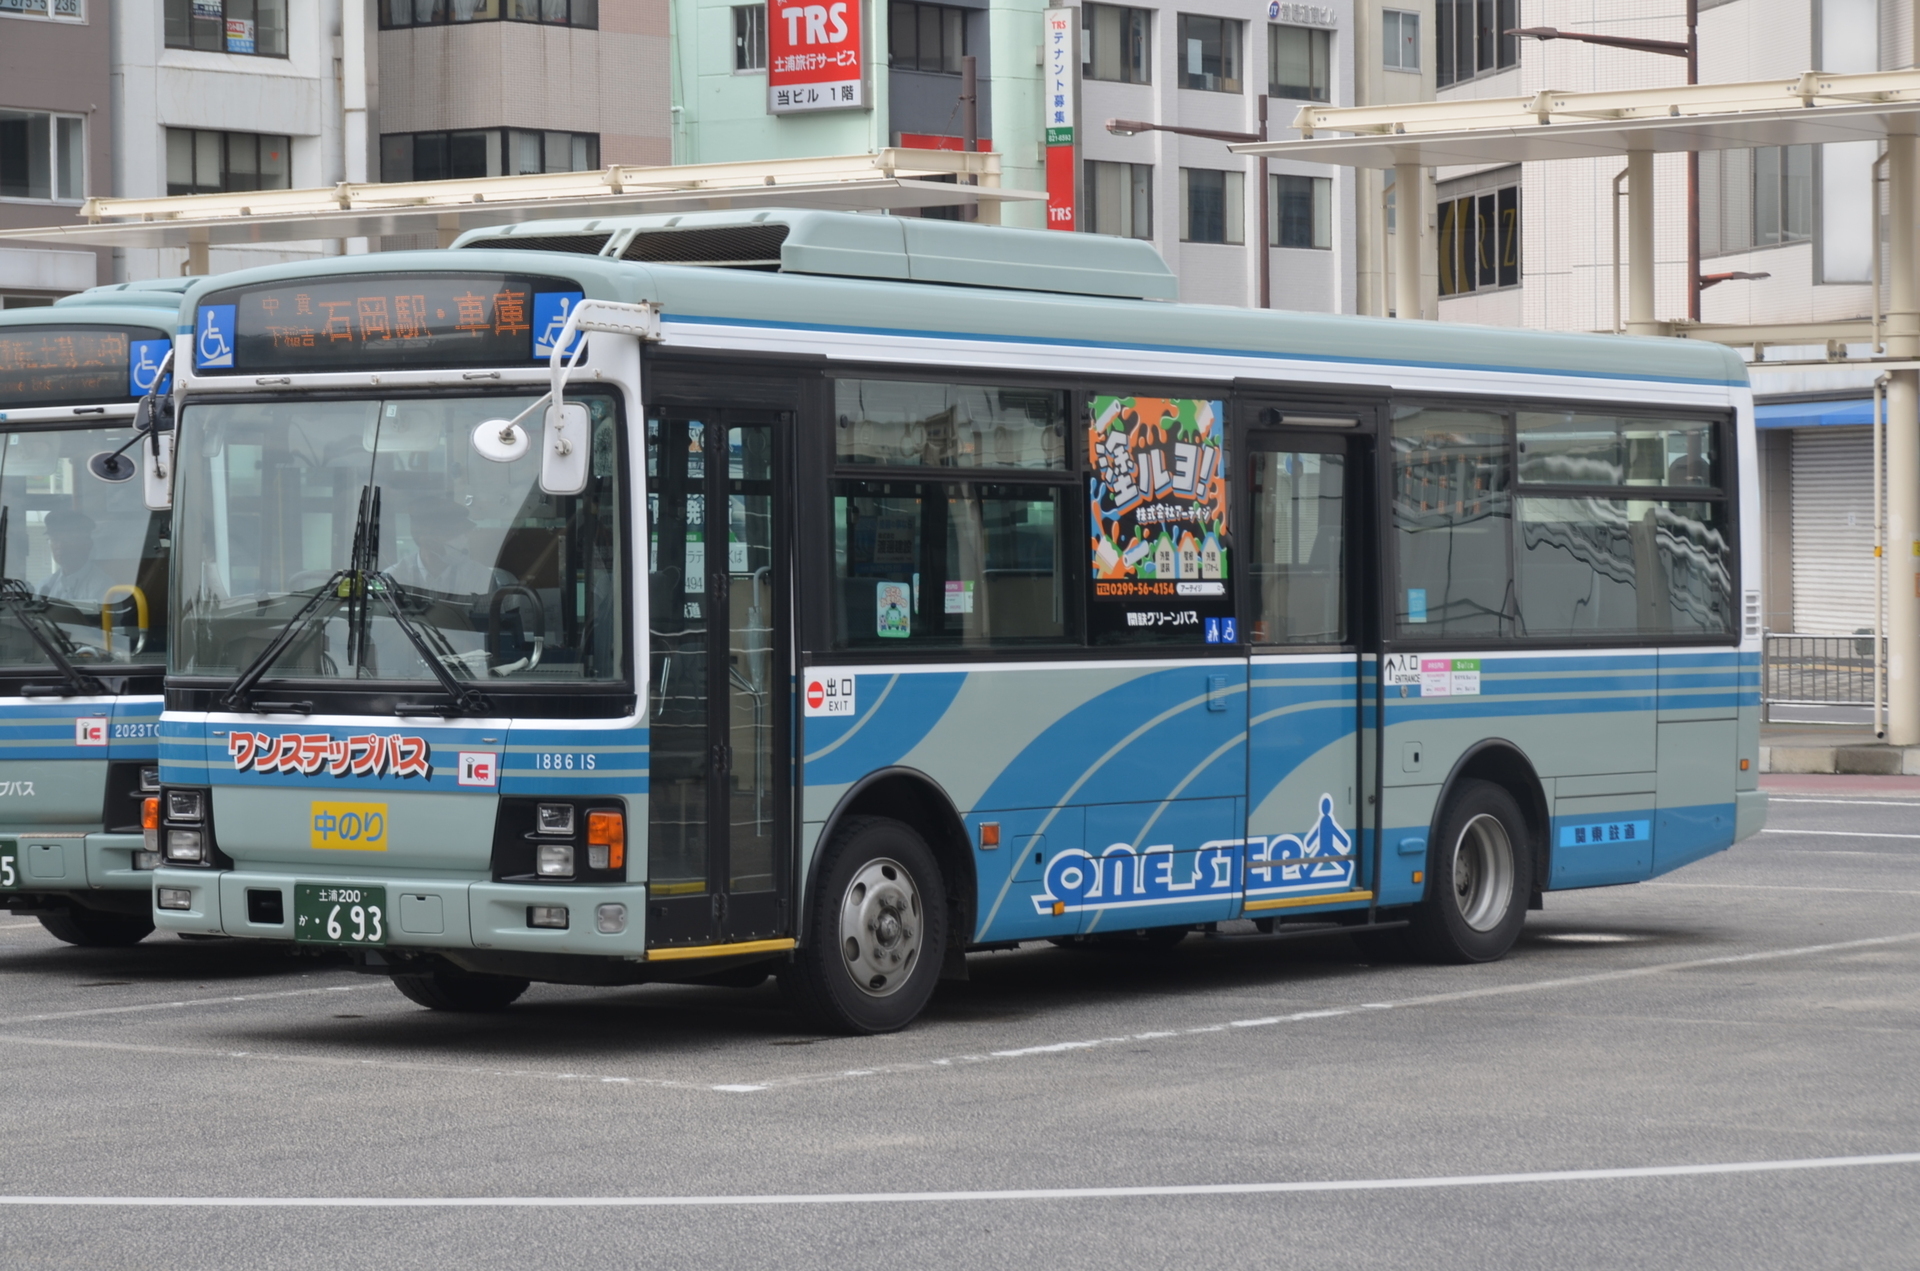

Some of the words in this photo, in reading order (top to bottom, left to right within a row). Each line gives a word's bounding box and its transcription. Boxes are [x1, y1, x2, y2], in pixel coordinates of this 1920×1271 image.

[781, 2, 848, 46] TRS
[1051, 20, 1067, 30] TRS
[774, 50, 857, 73] 土浦旅行サービス
[1053, 32, 1066, 124] テナント募集
[777, 88, 820, 106] 当ビル
[830, 85, 854, 102] 1階
[1050, 206, 1072, 221] TRS
[1098, 584, 1109, 594] TEL
[1111, 583, 1175, 595] 0299-56-4154
[1127, 611, 1199, 626] 関鉄グリーンバス
[1398, 654, 1418, 671] 入口
[1456, 661, 1475, 669] Suica
[1395, 674, 1421, 683] ENTRANCE
[826, 678, 852, 697] 出口
[828, 700, 848, 711] EXIT
[227, 730, 431, 781] ワンステップバス
[314, 810, 385, 842] 中のり
[1575, 823, 1636, 844] 関東鉄道
[298, 914, 309, 927] か
